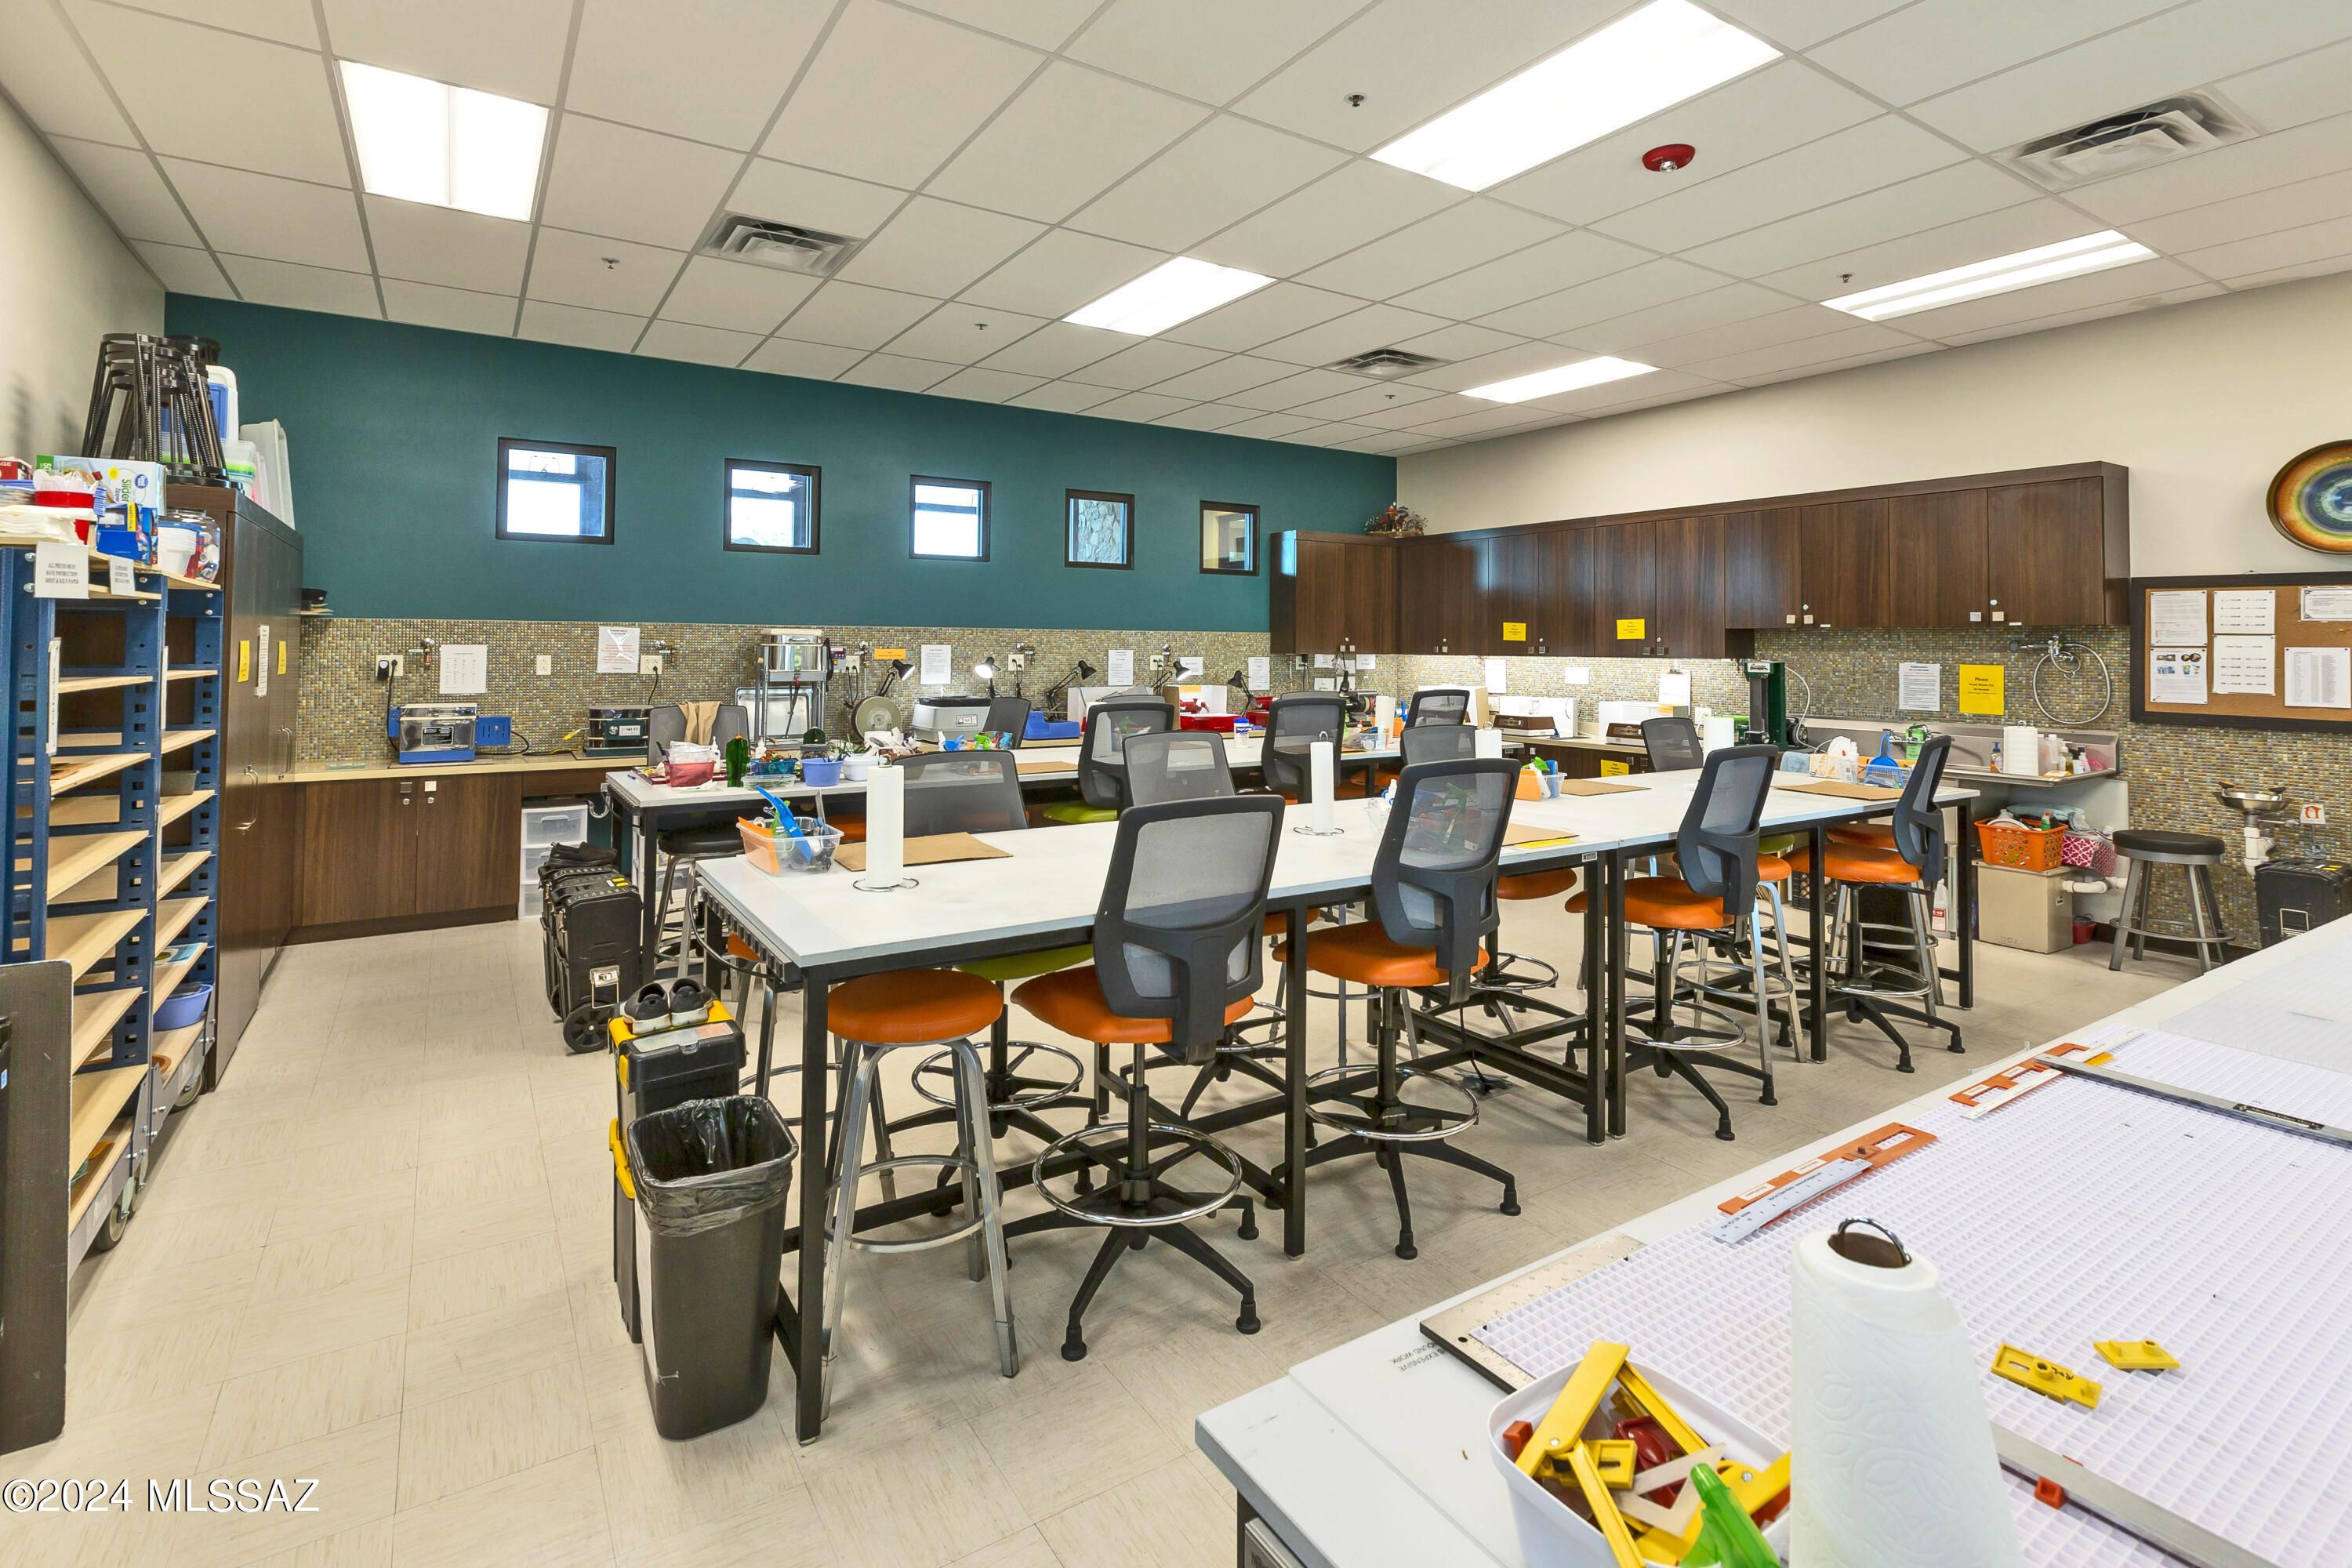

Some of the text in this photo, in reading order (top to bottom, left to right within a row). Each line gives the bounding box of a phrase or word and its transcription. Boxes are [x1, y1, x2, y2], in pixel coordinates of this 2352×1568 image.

[122, 478, 132, 503] Slider
[1413, 1341, 1436, 1355] OUND
[1397, 1351, 1439, 1373] EXPENSIVE
